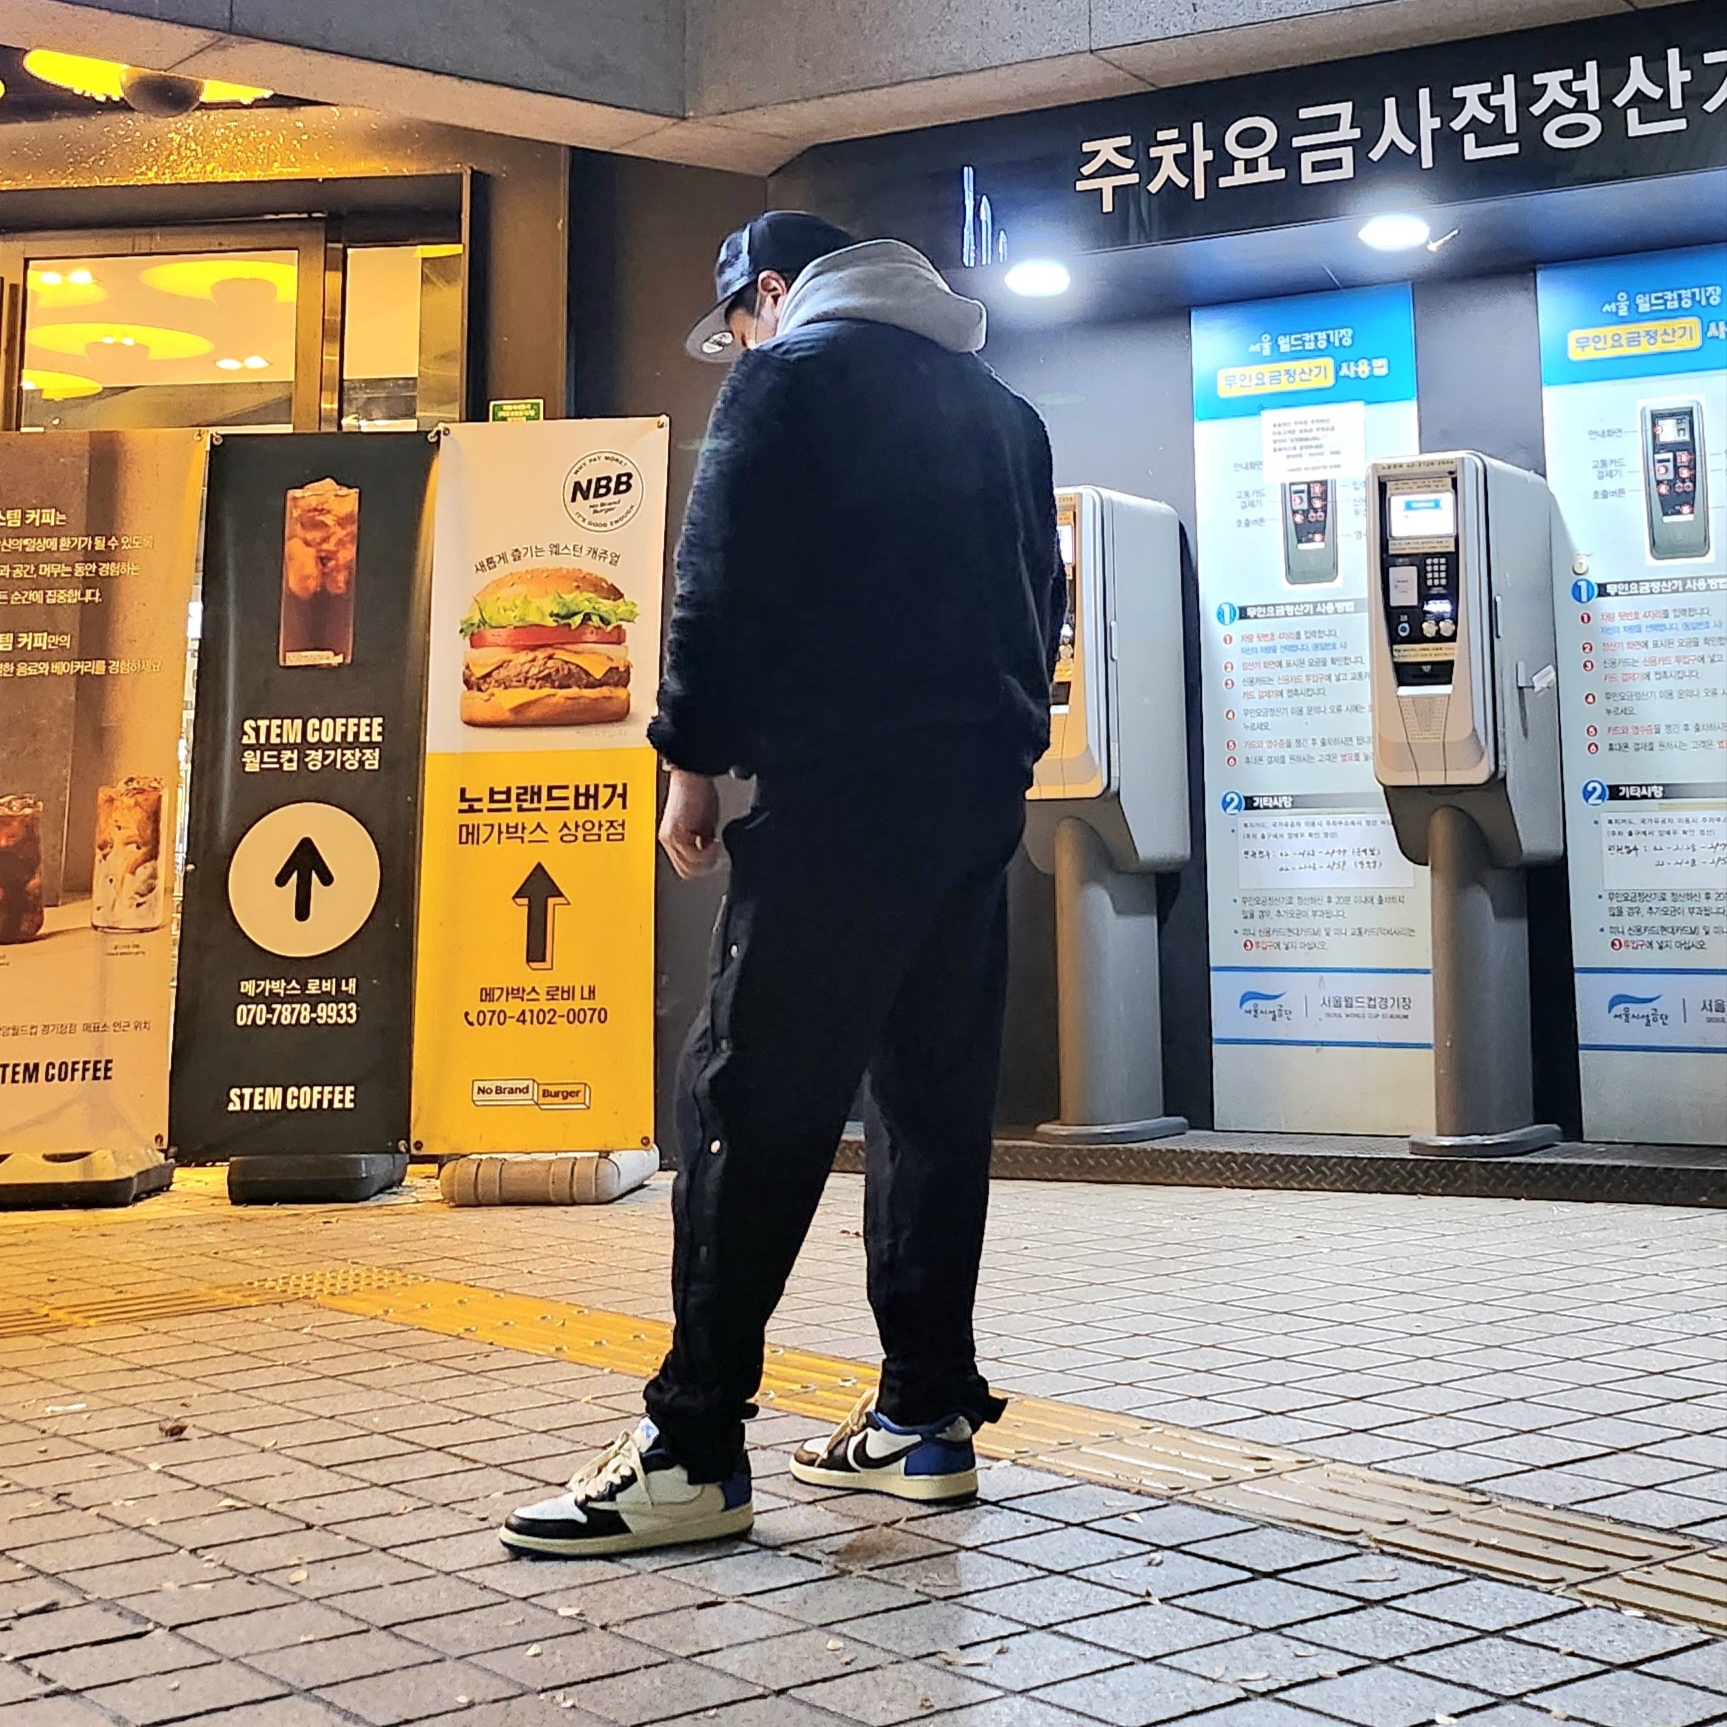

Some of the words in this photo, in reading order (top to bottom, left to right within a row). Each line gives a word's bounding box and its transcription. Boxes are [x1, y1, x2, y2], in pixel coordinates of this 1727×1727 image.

[1636, 286, 1722, 313] 월드컵경기장
[1277, 328, 1353, 353] 월드컵경기장
[1575, 326, 1693, 352] 무인요금정산기
[1224, 365, 1328, 390] 무인요금정산기
[1339, 357, 1389, 379] 사용법
[573, 460, 587, 475] WHY
[588, 456, 602, 464] PAY
[1592, 458, 1626, 469] 교통카드
[570, 472, 634, 503] NBB
[25, 508, 67, 527] 커피는
[59, 536, 91, 551] 환기가
[94, 536, 106, 550] 될
[107, 537, 119, 549] 수
[474, 551, 509, 574] 새롭게
[510, 545, 546, 562] 즐기는
[548, 542, 584, 558] 웨스턴
[586, 546, 621, 567] 캐쥬얼
[39, 563, 72, 577] 머무는
[74, 563, 96, 577] 동안
[98, 562, 140, 577] 경험하는
[10, 590, 43, 604] 순간에
[45, 588, 102, 604] 집중합니다.
[1606, 581, 1682, 595] 무인요금정산기
[1246, 604, 1313, 618] 무인요금정산기
[17, 632, 71, 650] 커피만의
[16, 661, 49, 677] 음료와
[51, 659, 106, 675] 베이커리를
[241, 718, 303, 744] STEM
[306, 716, 384, 743] COFFEE
[241, 749, 298, 772] 월드컵
[304, 748, 380, 771] 경기장점
[458, 782, 628, 814] 노브랜드버거
[1619, 785, 1664, 798] 기타사항
[1252, 796, 1294, 808] 기타사항
[458, 821, 549, 846] 메가박스
[558, 818, 626, 844] 상암점
[240, 978, 302, 998] 메가박스
[305, 977, 336, 996] 로비
[341, 977, 357, 995] 내
[479, 986, 540, 1003] 메가박스
[545, 984, 575, 1002] 로비
[580, 984, 596, 1001] 내
[1320, 995, 1412, 1010] 서울월드컵경기장
[236, 1002, 357, 1026] 070-7878-9933
[476, 1007, 608, 1026] 070-4102-0070
[0, 1024, 38, 1037] 암월드컵
[112, 1020, 130, 1033] 인근
[133, 1020, 150, 1031] 위치
[44, 1058, 113, 1083] COFFEE
[226, 1087, 283, 1112] STEM
[286, 1085, 355, 1110] COFFEE
[477, 1086, 493, 1095] No
[495, 1083, 529, 1095] Brand
[542, 1088, 582, 1101] Burger
